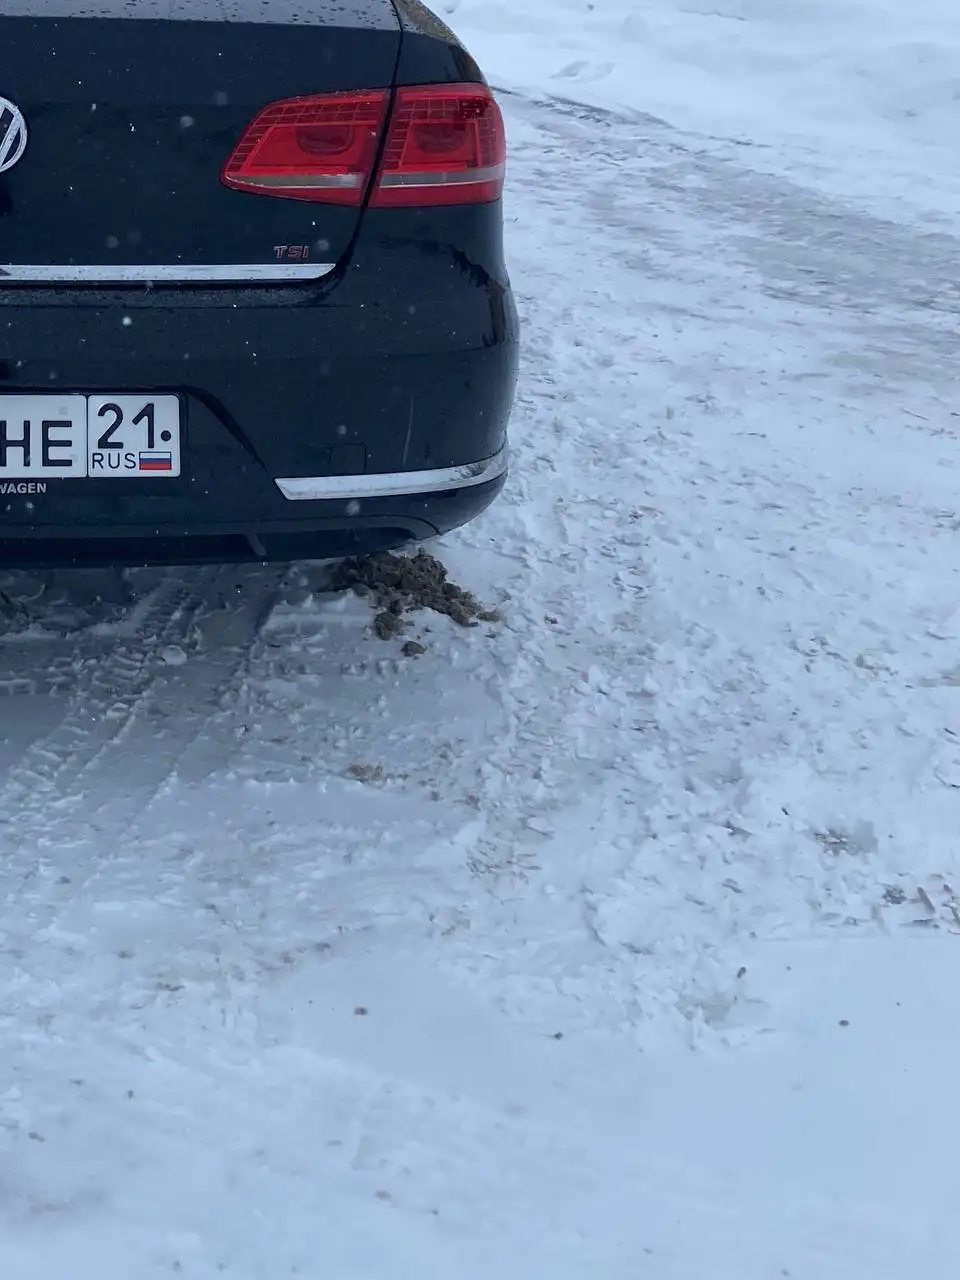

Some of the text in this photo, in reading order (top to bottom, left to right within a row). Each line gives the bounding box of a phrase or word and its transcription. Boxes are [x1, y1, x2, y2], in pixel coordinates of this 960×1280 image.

[273, 245, 310, 259] TSI
[97, 402, 155, 449] 21
[92, 452, 137, 470] RUS
